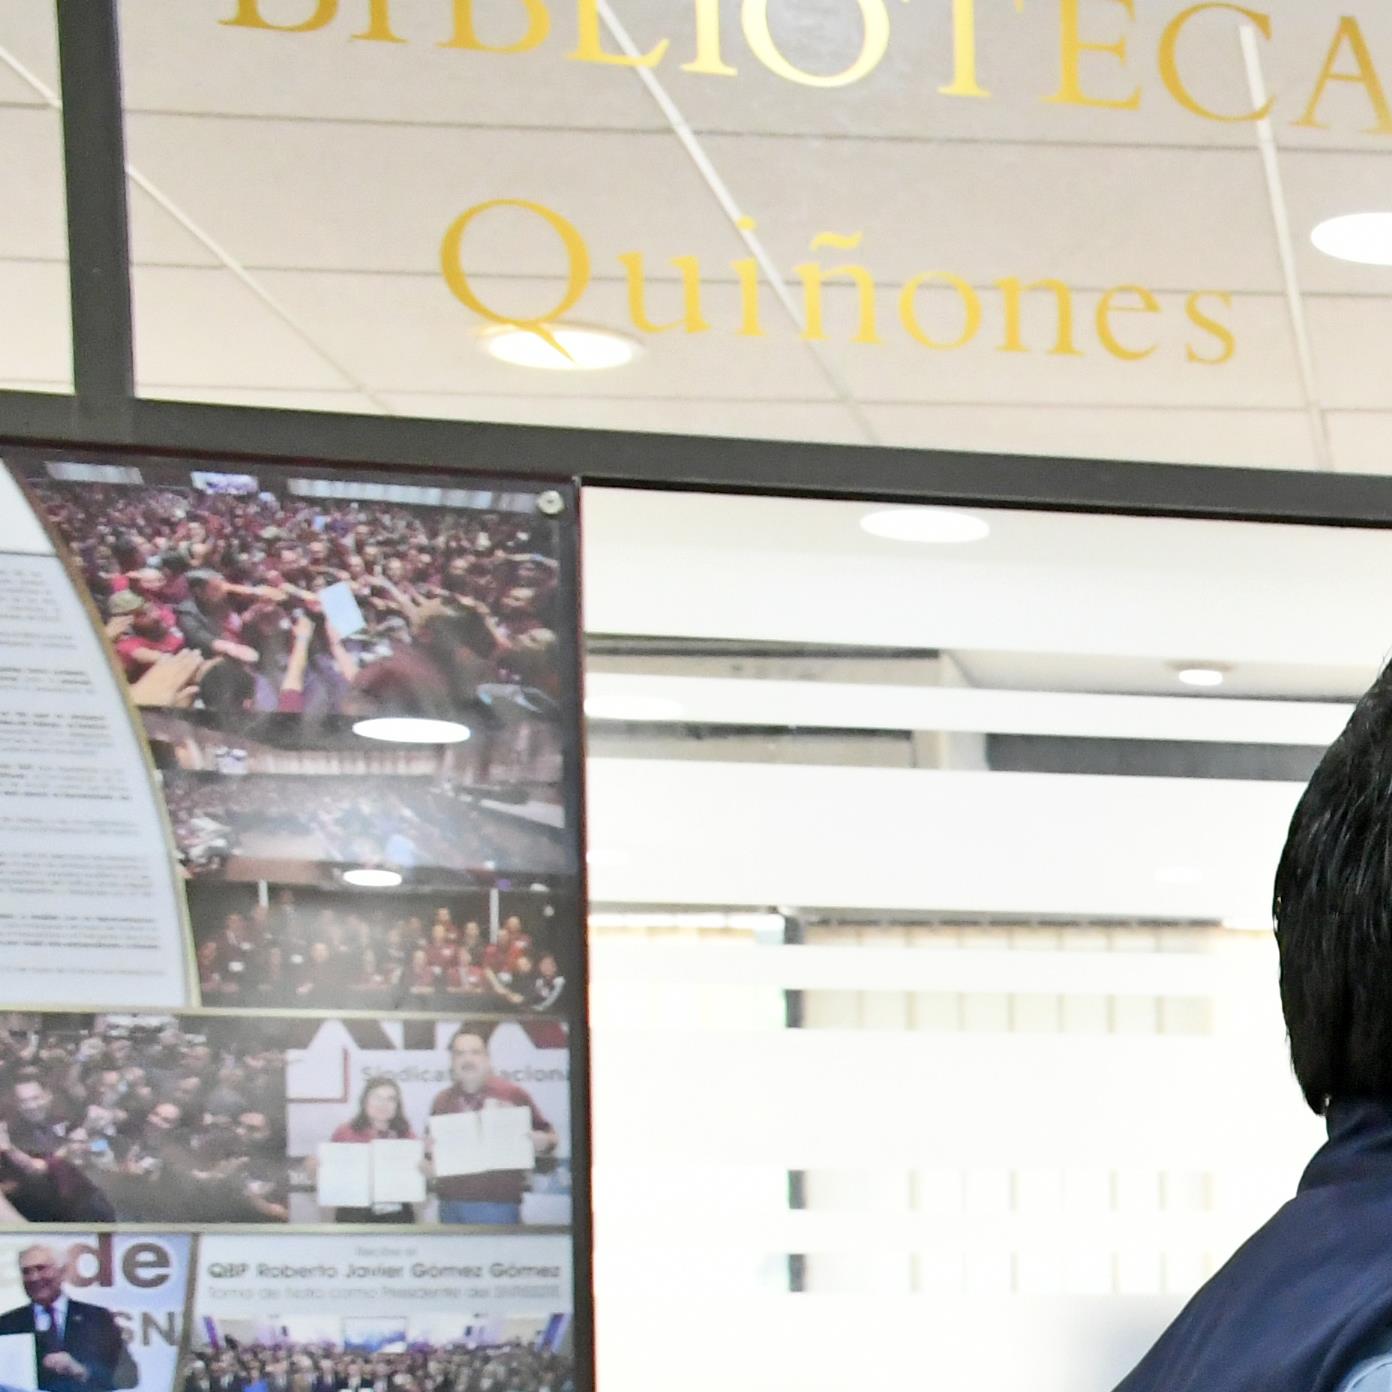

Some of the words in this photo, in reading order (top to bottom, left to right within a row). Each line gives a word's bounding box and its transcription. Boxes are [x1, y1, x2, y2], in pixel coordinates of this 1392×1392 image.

[439, 198, 1237, 365] Quiñones
[256, 1262, 338, 1278] Roberto
[346, 1262, 403, 1278] Javier
